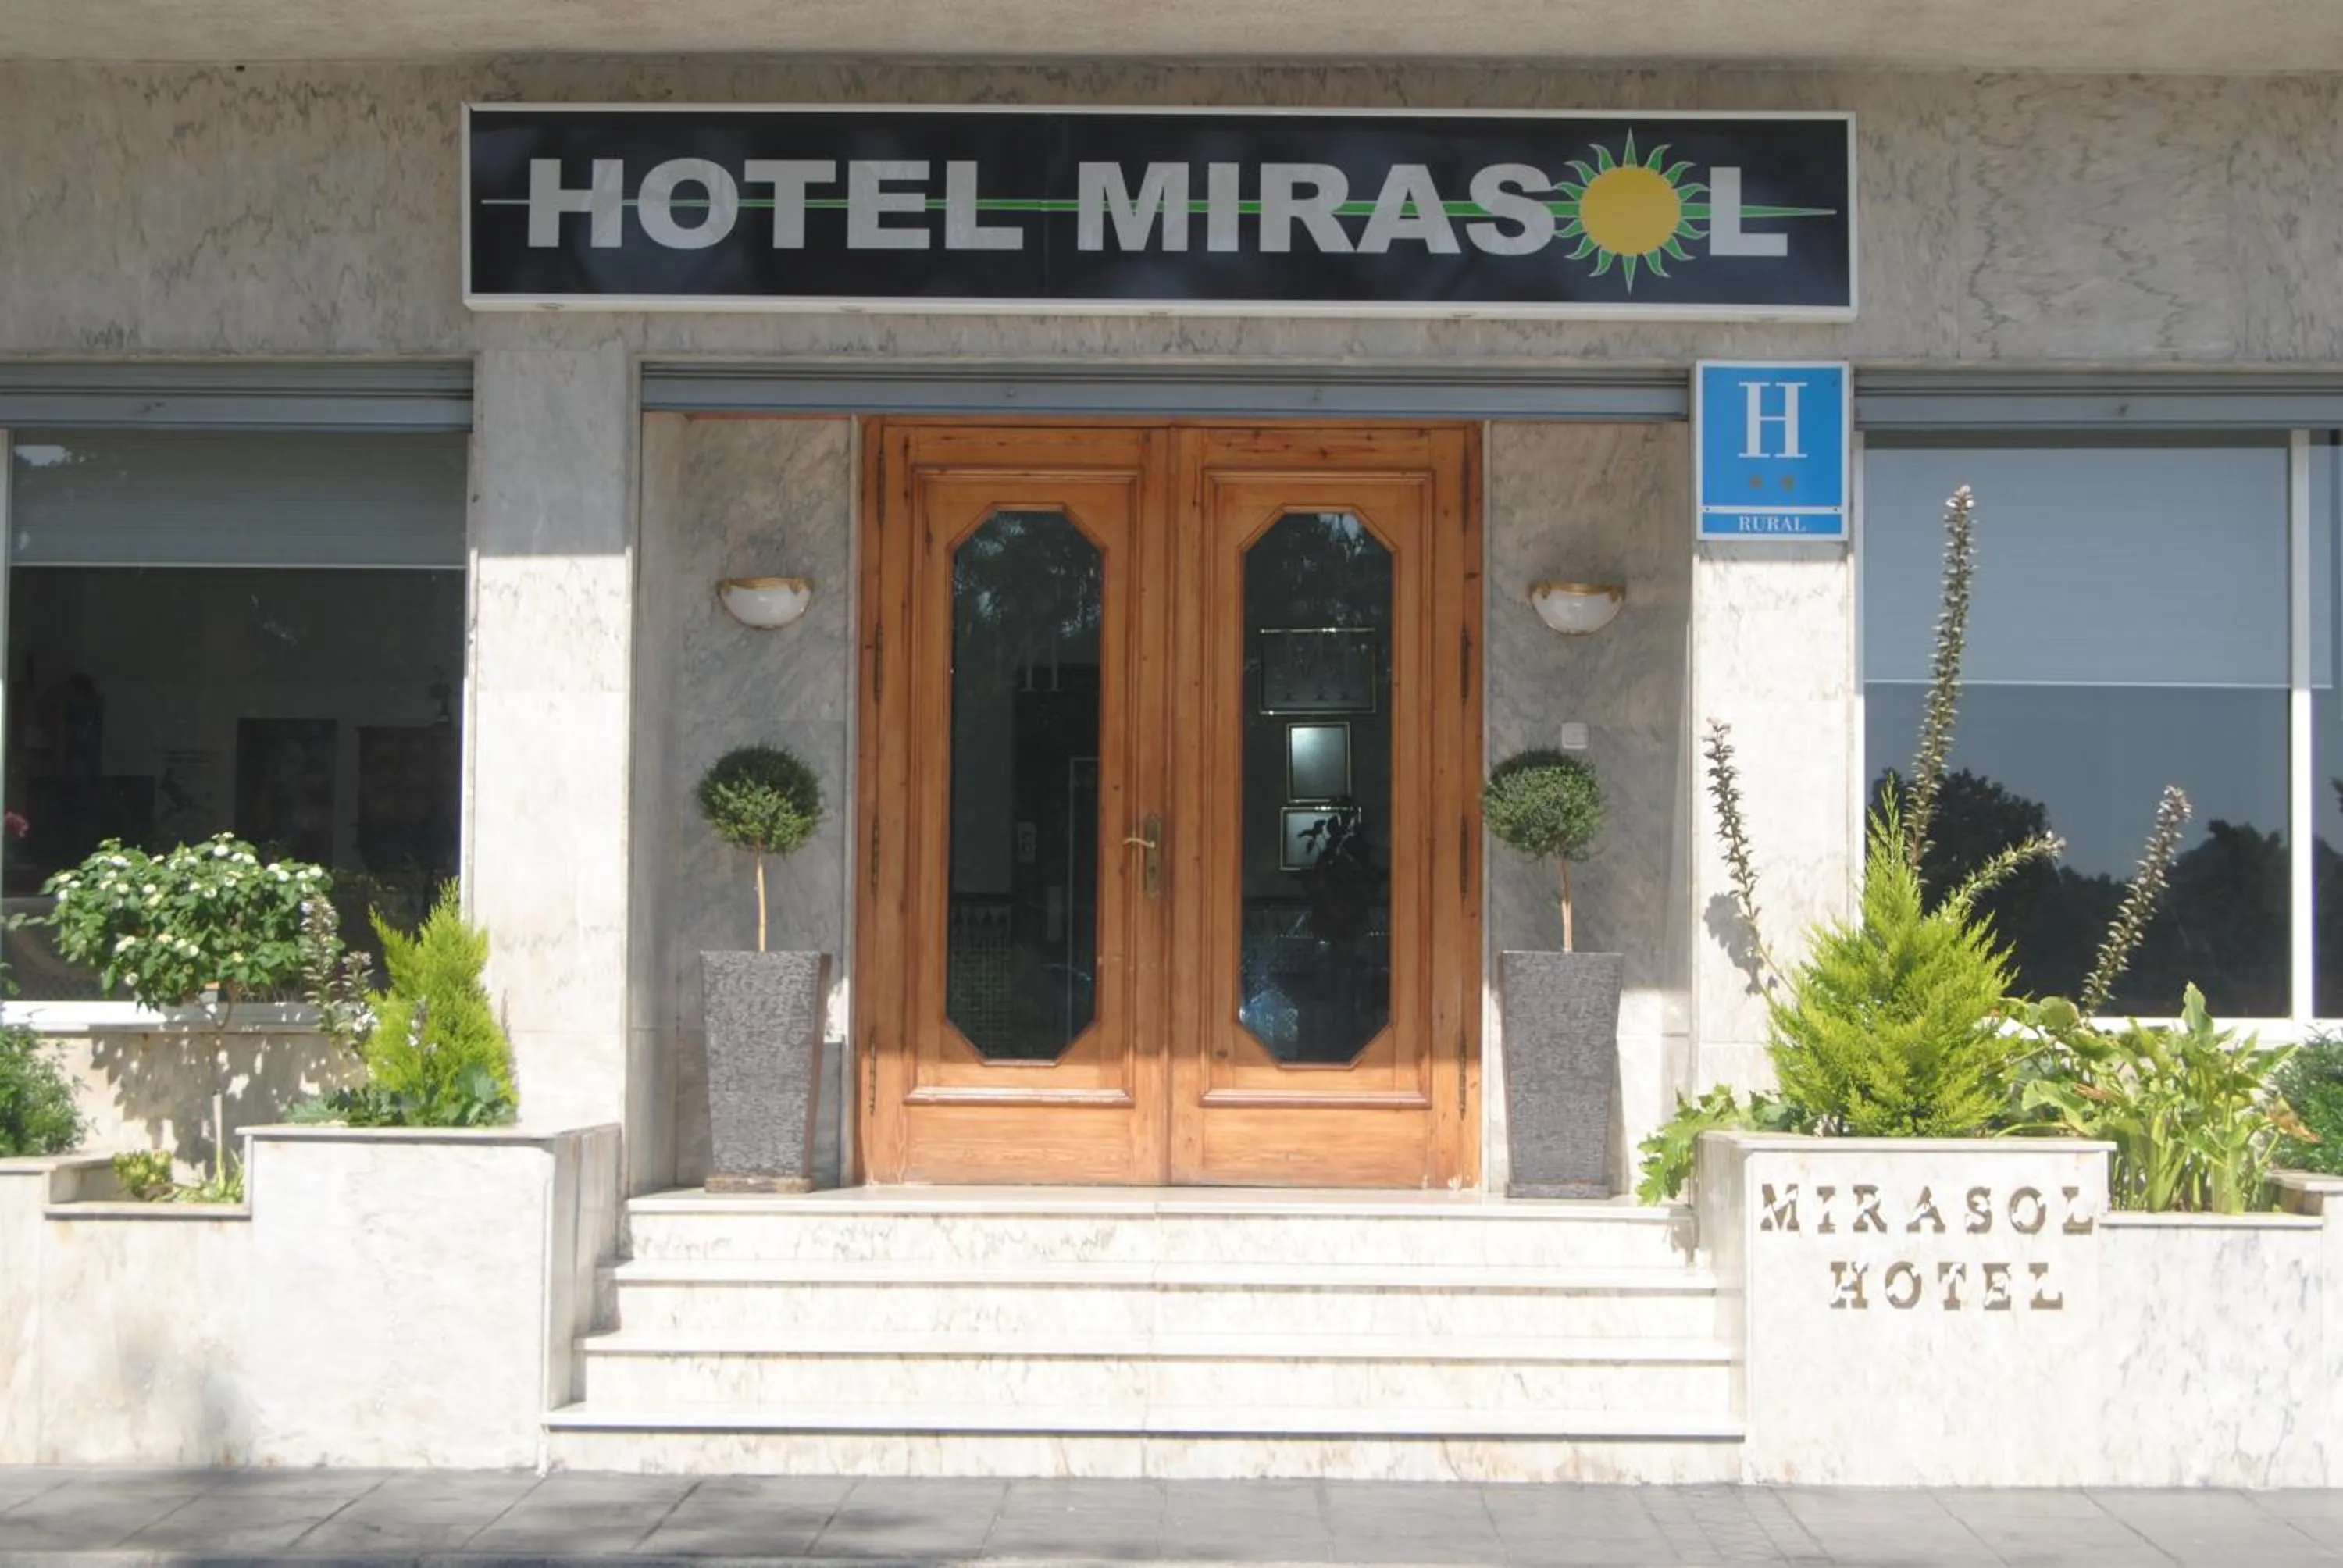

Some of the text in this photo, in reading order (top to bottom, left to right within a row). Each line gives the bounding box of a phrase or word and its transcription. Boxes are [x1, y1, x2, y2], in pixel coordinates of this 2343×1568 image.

[527, 158, 1788, 261] HOTEL MIRASOL
[1738, 382, 1808, 458] H
[1739, 515, 1806, 532] RURAL
[1760, 1184, 2095, 1235] MIRASOL
[1830, 1260, 2063, 1310] HOTEL
